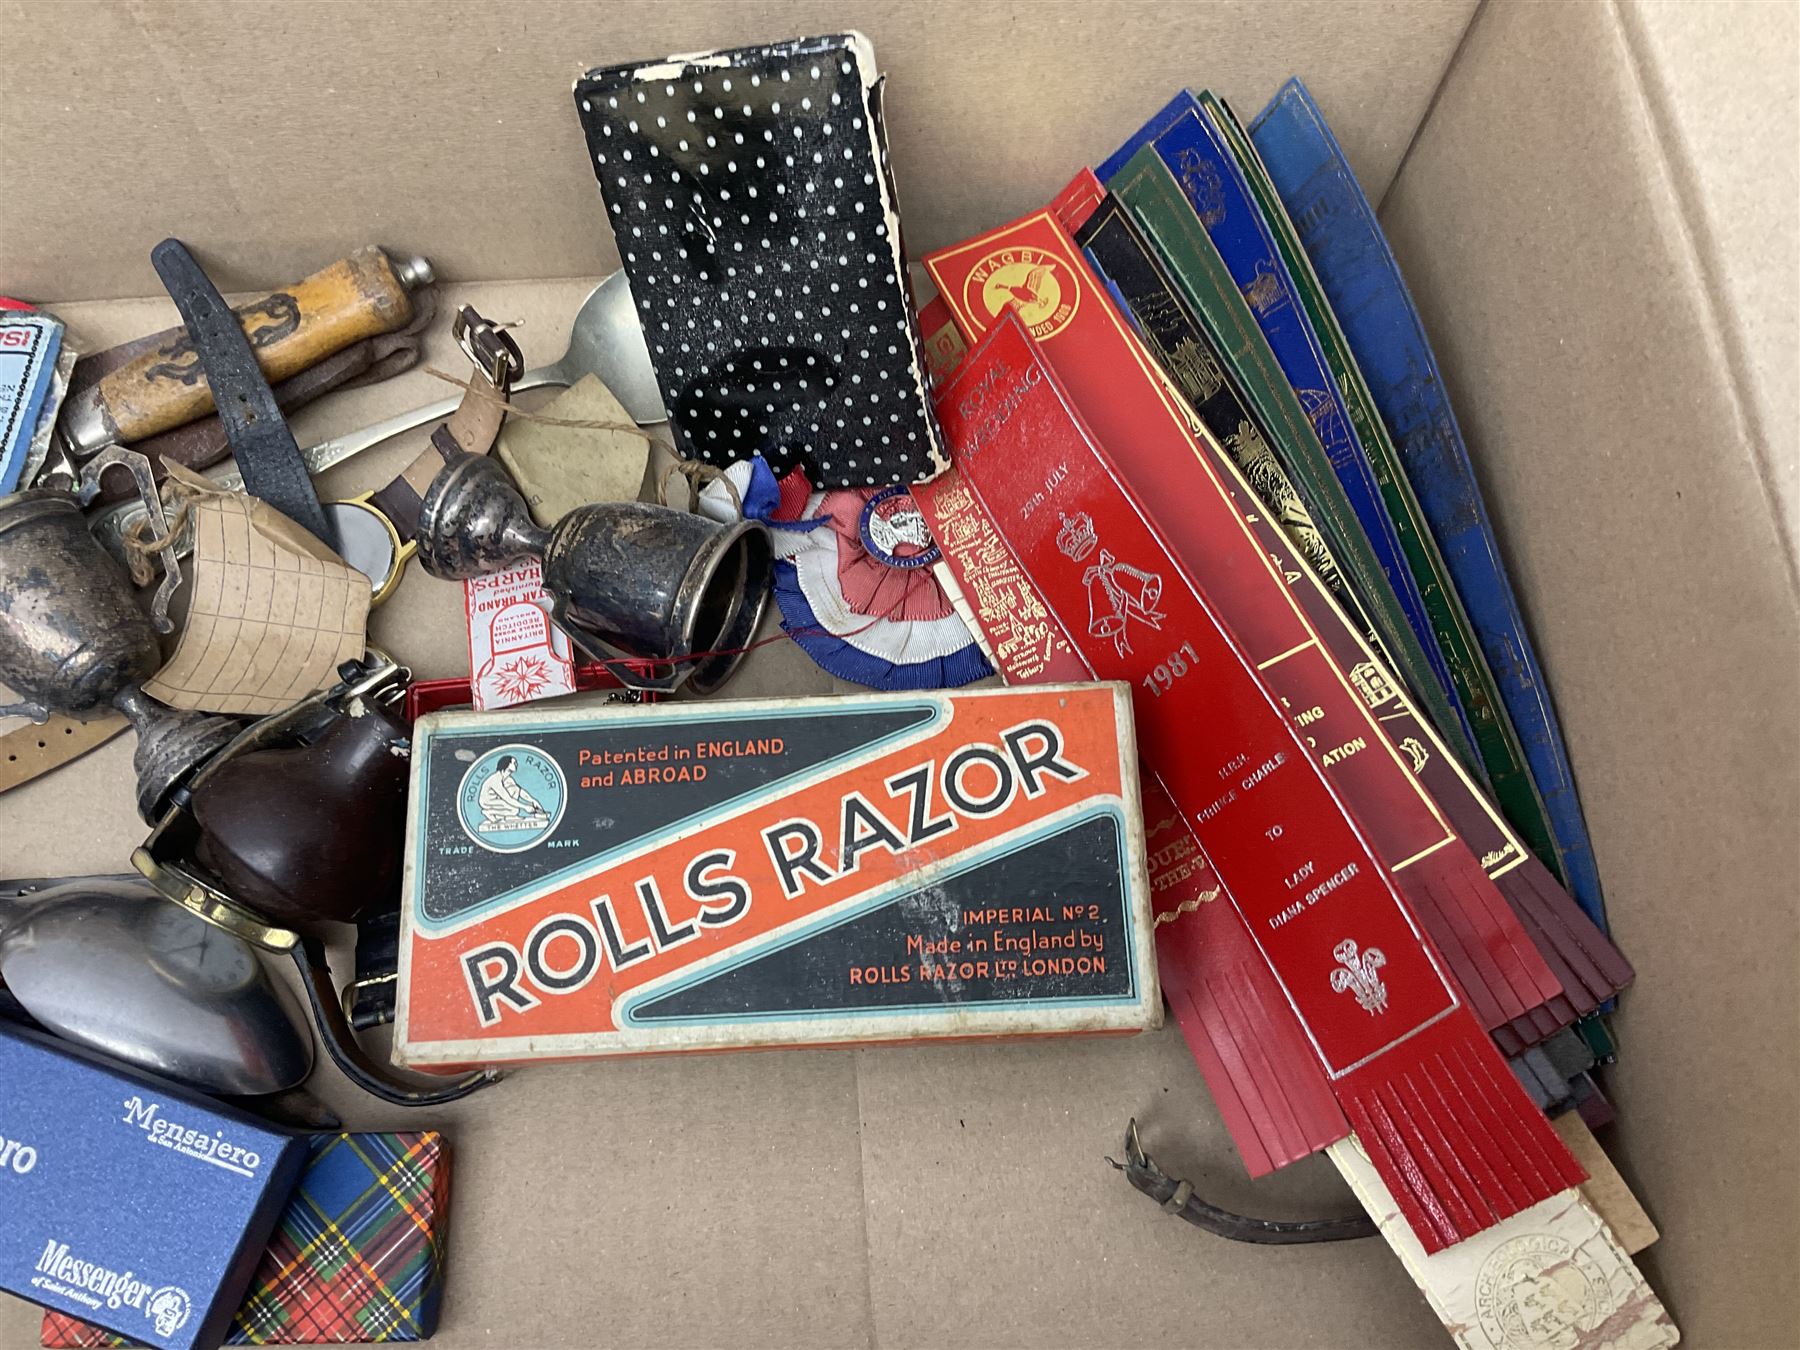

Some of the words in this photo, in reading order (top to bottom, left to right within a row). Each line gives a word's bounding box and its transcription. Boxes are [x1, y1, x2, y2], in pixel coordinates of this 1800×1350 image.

[972, 250, 1045, 284] WAGBI
[960, 362, 1008, 420] ROYAL
[961, 362, 1042, 462] WEDDING
[1045, 461, 1070, 495] JULY
[478, 595, 517, 613] BRAND
[1143, 641, 1200, 697] 1981
[1294, 705, 1326, 728] ING
[578, 747, 669, 767] Patented
[673, 746, 692, 760] in
[696, 737, 785, 760] ENGLAND
[467, 766, 491, 803] ROLLS
[525, 755, 557, 790] RAZOR
[580, 771, 614, 789] and
[620, 765, 708, 787] ABROAD
[547, 839, 581, 849] MARK
[1265, 825, 1284, 842] TO
[438, 846, 475, 856] TRADE
[459, 848, 753, 1029] ROLLS
[760, 718, 1091, 901] RAZOR
[1284, 860, 1316, 890] LADY
[1268, 900, 1306, 930] DIANA
[1305, 861, 1361, 906] SPENCER
[962, 906, 1055, 926] IMPERIAL
[906, 934, 962, 956] Made
[967, 933, 988, 954] in
[993, 930, 1077, 958] England
[1079, 928, 1105, 953] by
[849, 965, 912, 986] ROLLS
[919, 961, 989, 982] RAZOR
[1022, 956, 1106, 977] LONDON
[122, 1096, 261, 1169] Mensajero
[157, 1135, 173, 1148] San
[34, 1238, 153, 1310] Messenger
[42, 1279, 67, 1295] Saint
[64, 1287, 103, 1311] Anthony
